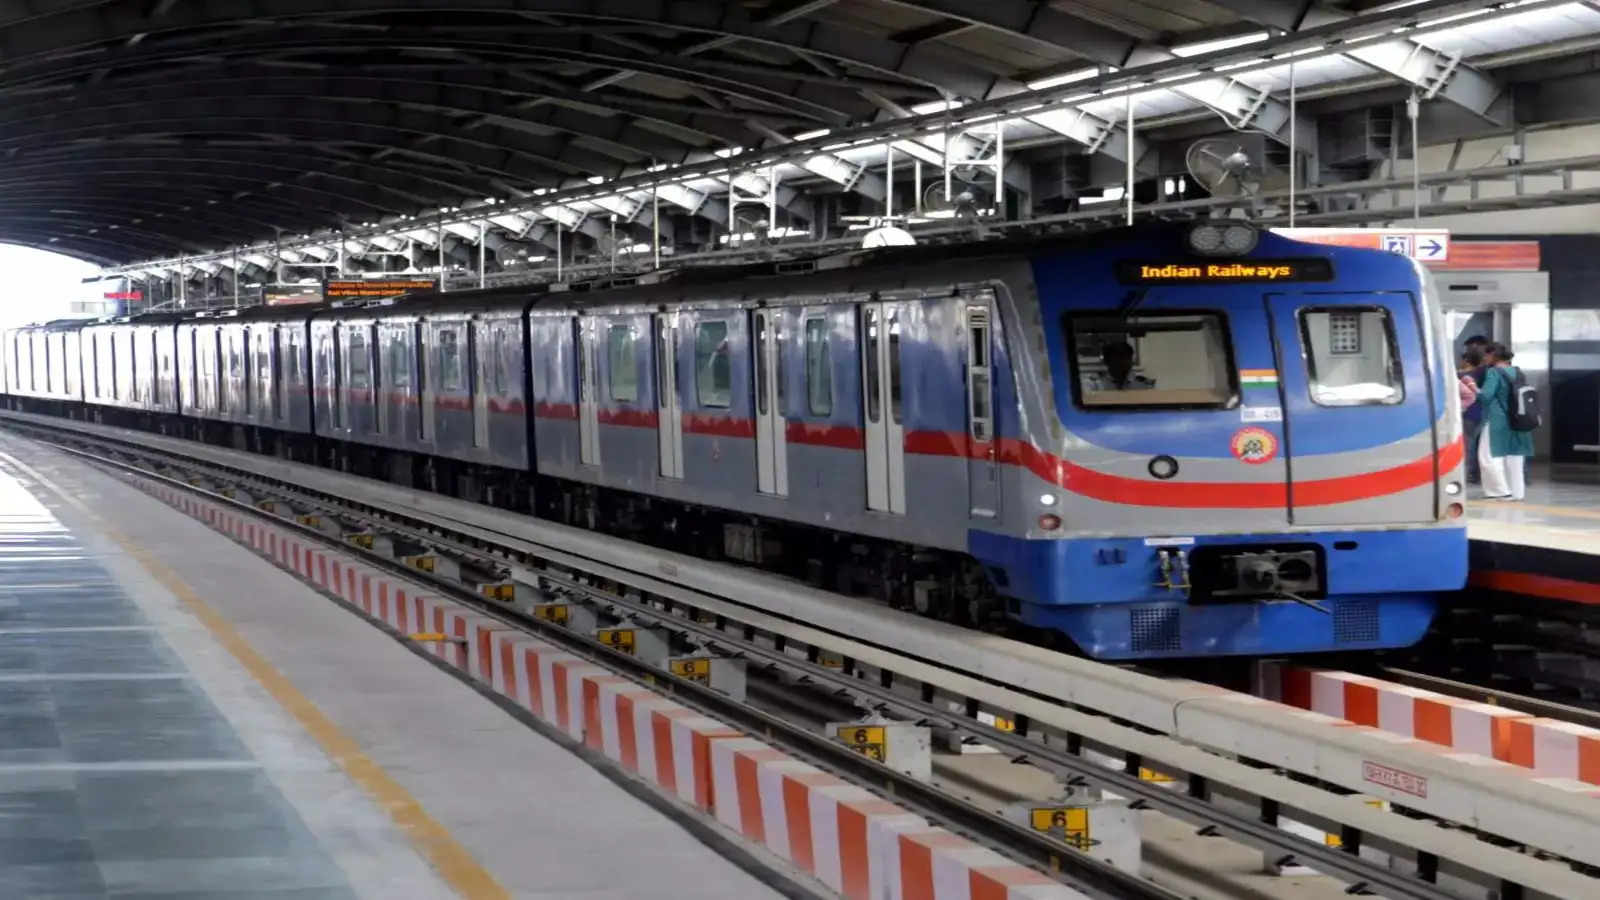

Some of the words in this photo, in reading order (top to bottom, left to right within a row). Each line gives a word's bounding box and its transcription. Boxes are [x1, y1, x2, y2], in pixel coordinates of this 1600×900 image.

[1141, 264, 1201, 278] Indian
[1207, 263, 1291, 279] Railways
[854, 728, 869, 744] 6
[1051, 810, 1068, 828] 6
